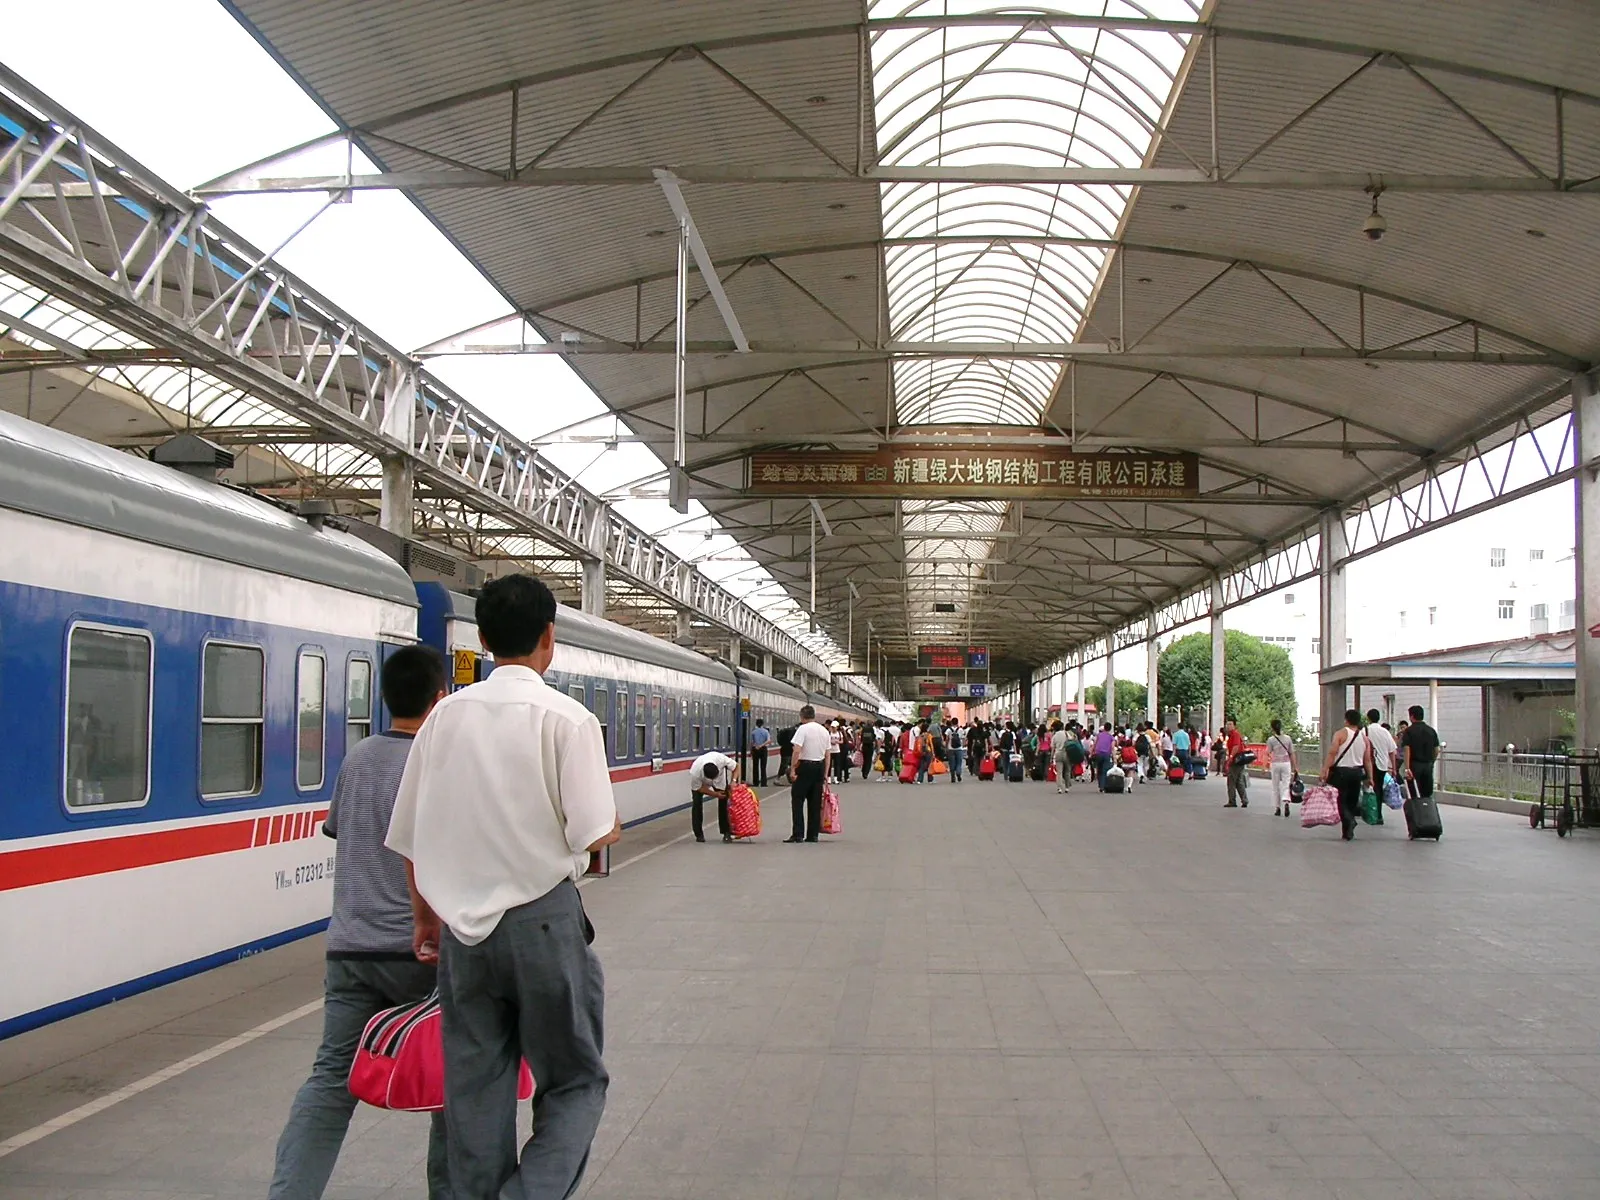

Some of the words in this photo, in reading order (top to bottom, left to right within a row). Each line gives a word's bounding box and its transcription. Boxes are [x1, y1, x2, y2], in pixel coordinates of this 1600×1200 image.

[893, 457, 1185, 486] 新疆绿大地钢结构工程有限公司承建
[295, 862, 324, 885] 672312
